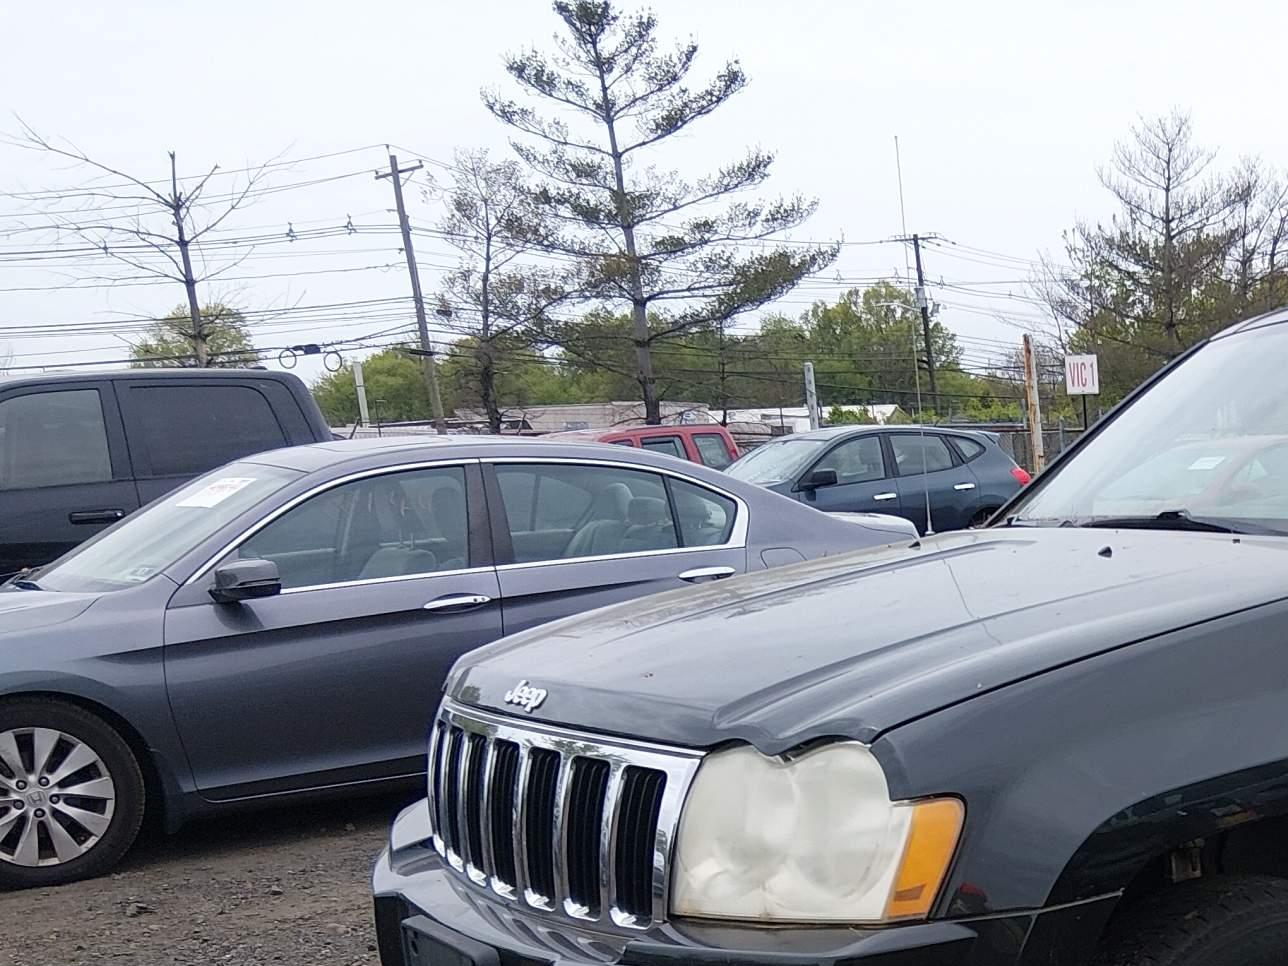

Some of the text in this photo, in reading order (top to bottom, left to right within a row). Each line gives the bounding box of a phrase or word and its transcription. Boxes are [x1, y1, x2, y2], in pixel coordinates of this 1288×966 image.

[1069, 361, 1095, 388] VIC 1
[504, 679, 548, 713] Jeep
